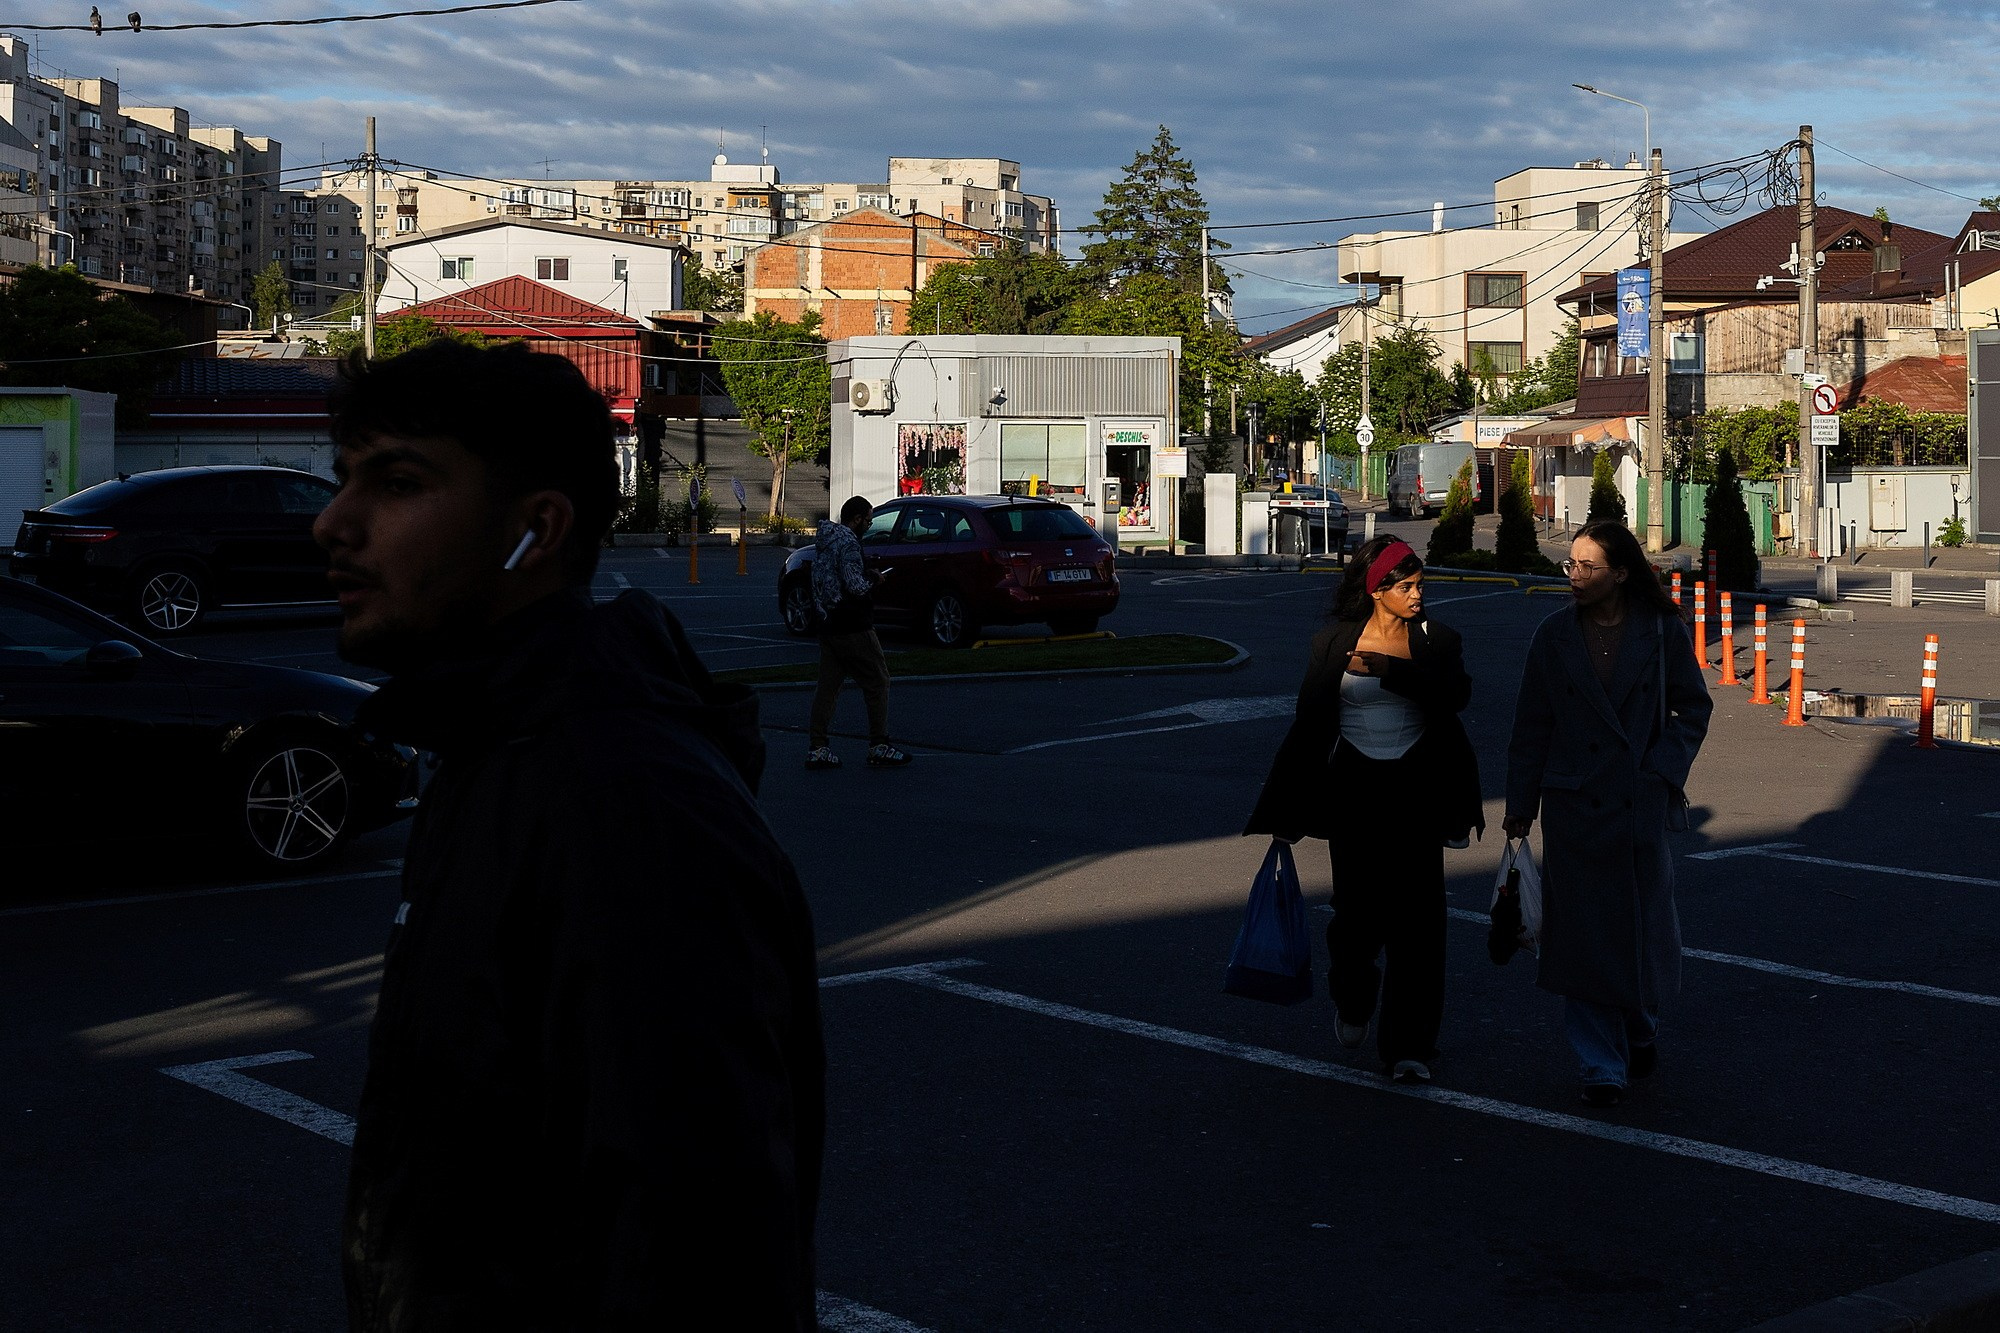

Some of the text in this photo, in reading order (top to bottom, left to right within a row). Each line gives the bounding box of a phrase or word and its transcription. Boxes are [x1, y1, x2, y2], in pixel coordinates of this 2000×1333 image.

[1115, 431, 1143, 443] DESCHIS
[1479, 427, 1500, 437] PIESE
[1360, 433, 1370, 443] 30
[1054, 571, 1061, 580] IF
